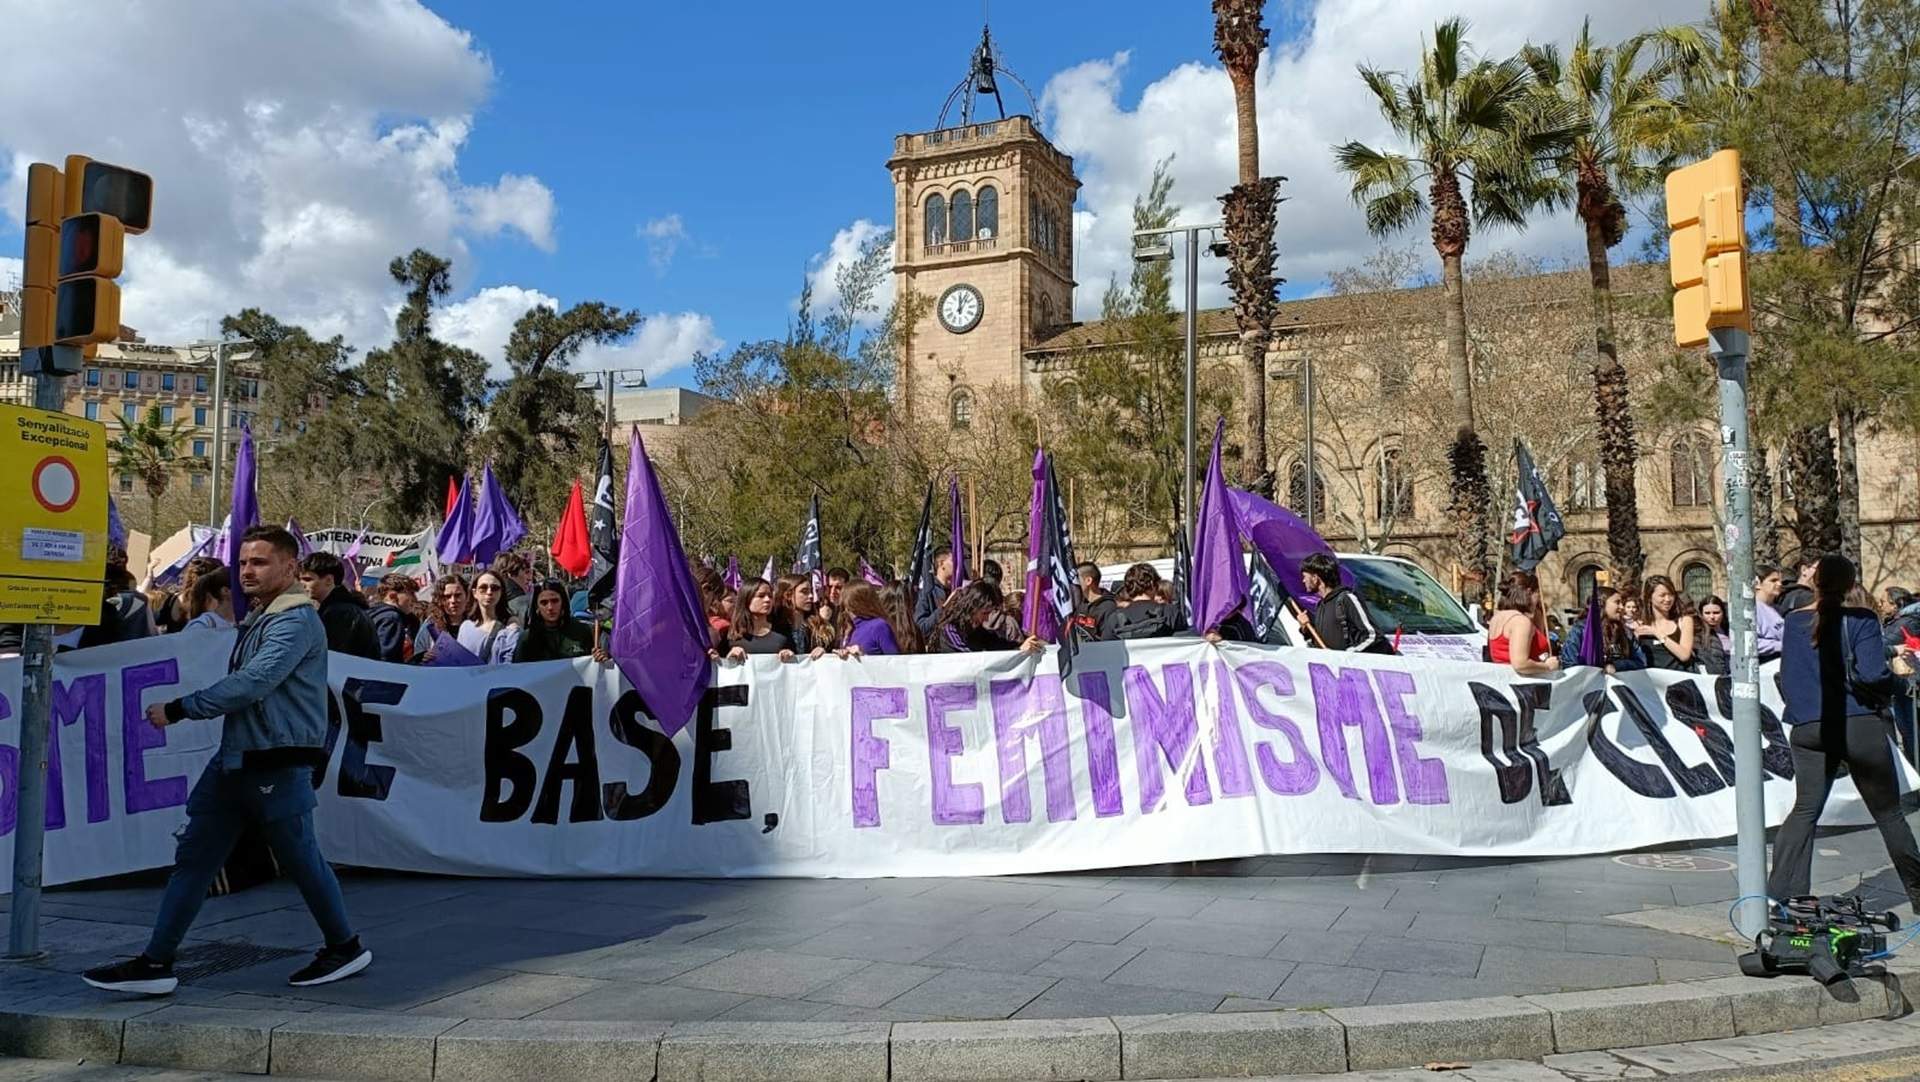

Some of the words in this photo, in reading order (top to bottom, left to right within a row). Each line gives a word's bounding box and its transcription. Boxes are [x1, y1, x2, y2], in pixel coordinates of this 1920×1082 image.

[17, 417, 90, 439] Senyalització
[21, 430, 89, 452] Excepcional
[316, 531, 415, 548] INTERNACIONA
[359, 555, 383, 567] TINA
[480, 684, 778, 834] BASE,
[850, 661, 1451, 827] FEMINISME
[1468, 680, 1573, 807] DE
